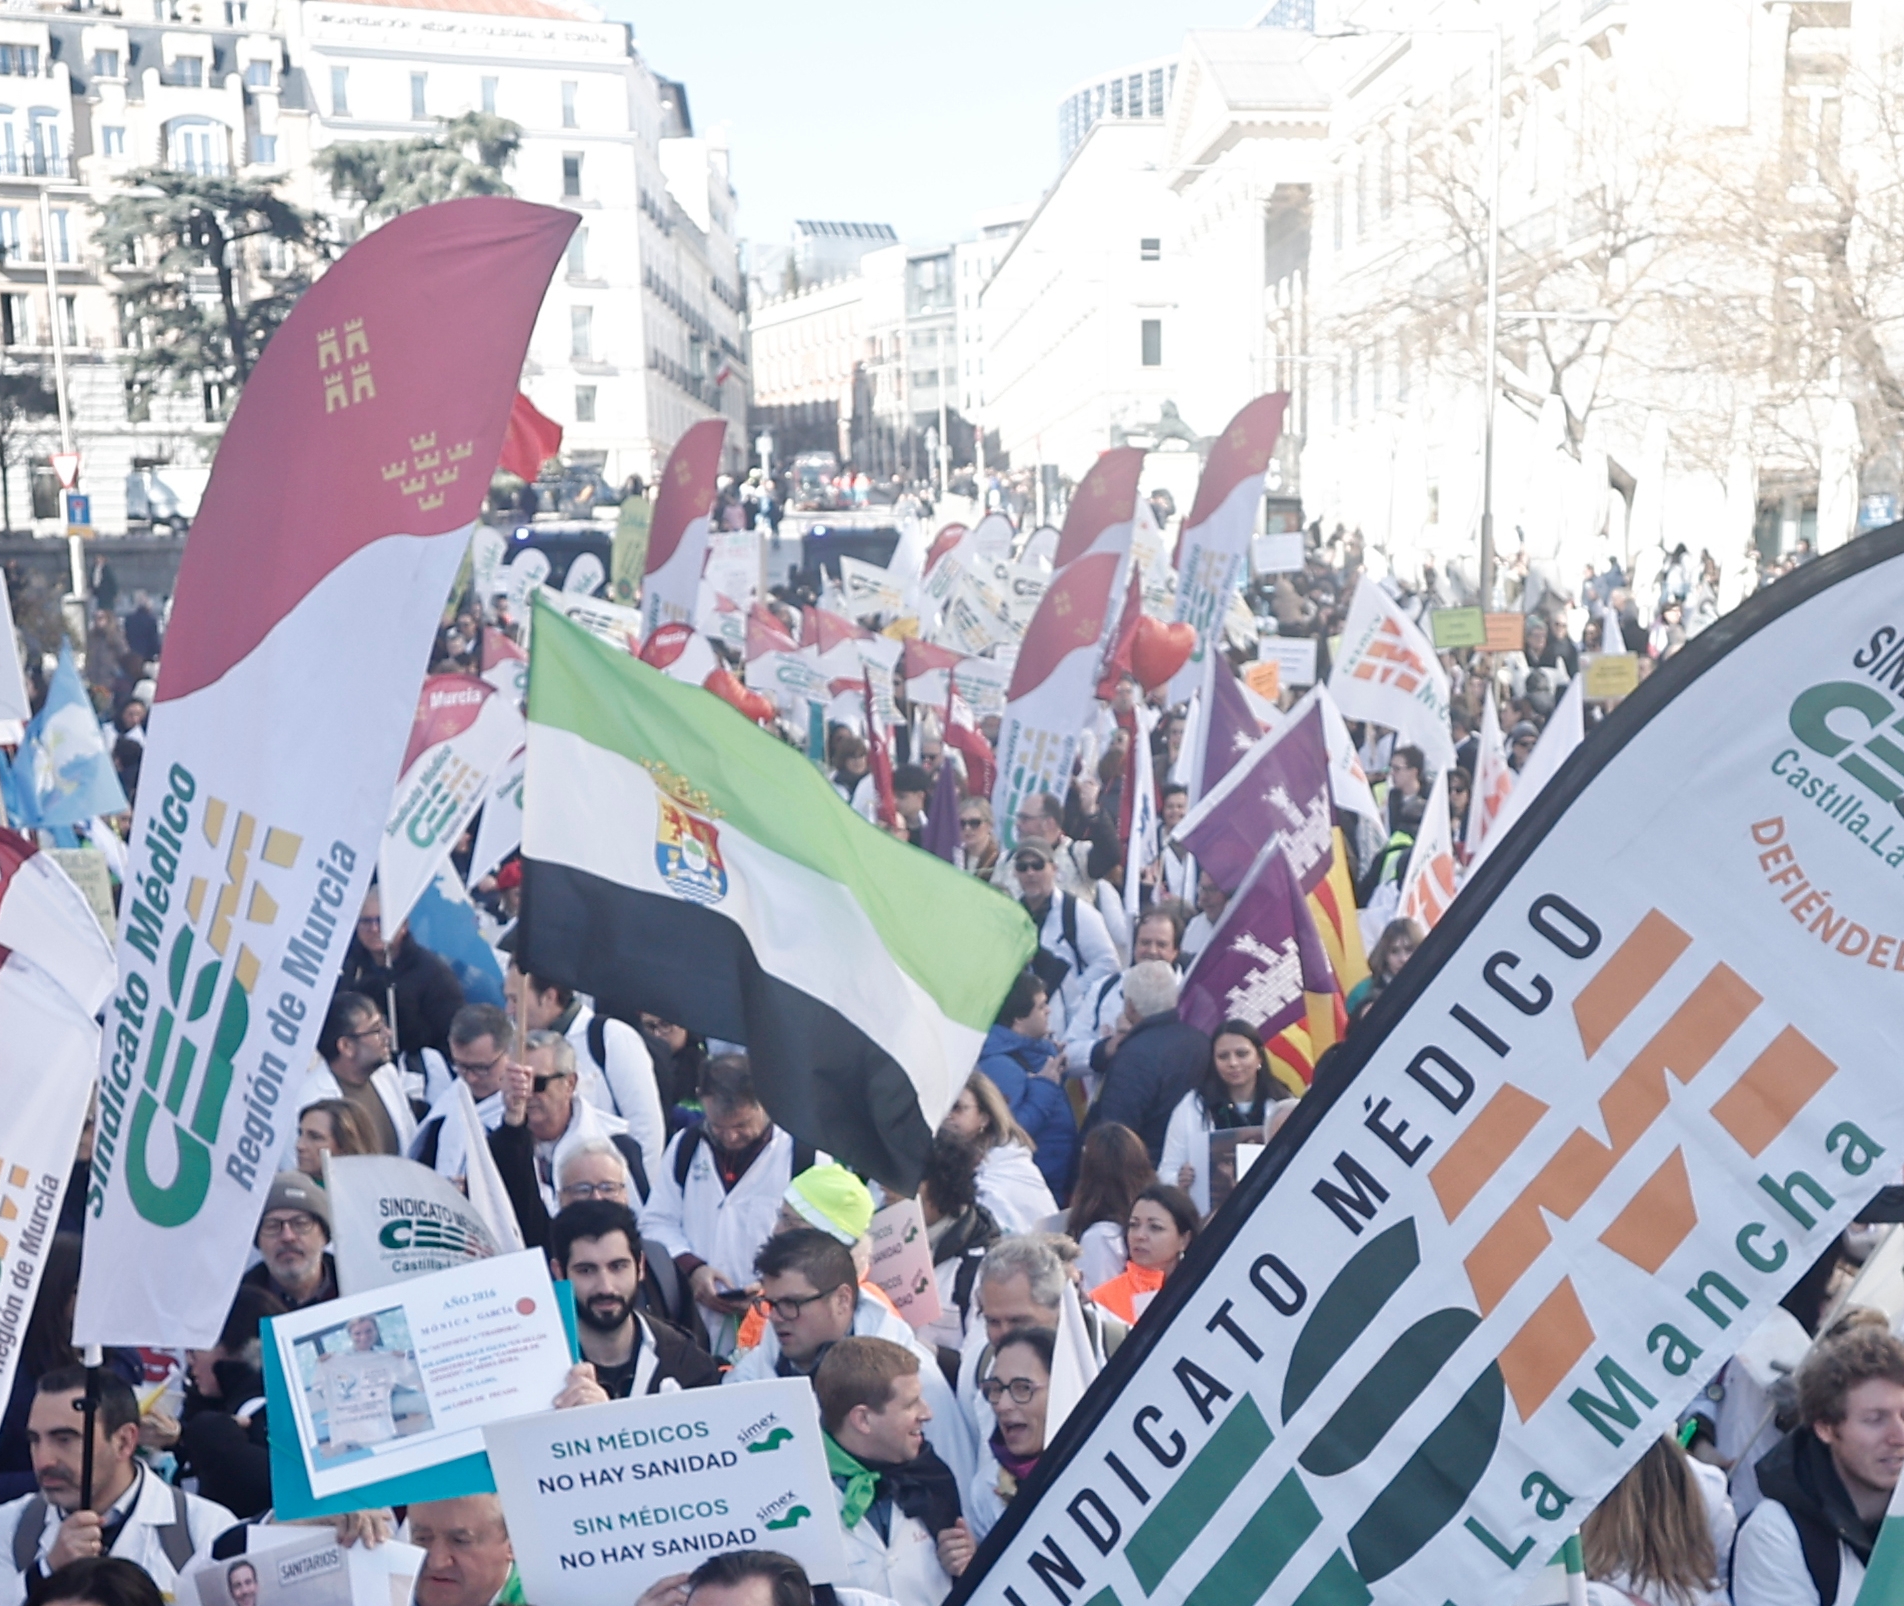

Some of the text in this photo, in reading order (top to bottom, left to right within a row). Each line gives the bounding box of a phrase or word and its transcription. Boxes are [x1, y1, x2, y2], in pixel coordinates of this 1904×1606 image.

[429, 687, 482, 709] Murcia
[85, 760, 198, 1220] Sindicato Médico
[124, 795, 304, 1229] CESM
[225, 839, 358, 1192] Región de Murcia
[1311, 893, 1603, 1235] MÉDICO
[19, 1171, 62, 1257] Murcia
[378, 1197, 453, 1223] SINDICATO
[13, 1250, 37, 1290] de
[443, 1288, 497, 1310] AÑO 2016
[421, 1304, 513, 1336] MÓNICA GARCÍA
[1462, 1466, 1574, 1571] La
[1568, 1120, 1887, 1449] Mancha
[550, 1420, 710, 1460] SIN MÉDICOS
[737, 1411, 778, 1444] simex
[537, 1450, 738, 1494] NO HAY SANIDAD
[573, 1499, 729, 1536] SIN MÉDICOS
[756, 1489, 798, 1522] simex
[279, 1549, 339, 1579] SANITARIOS
[560, 1527, 757, 1571] NO HAY SANIDAD
